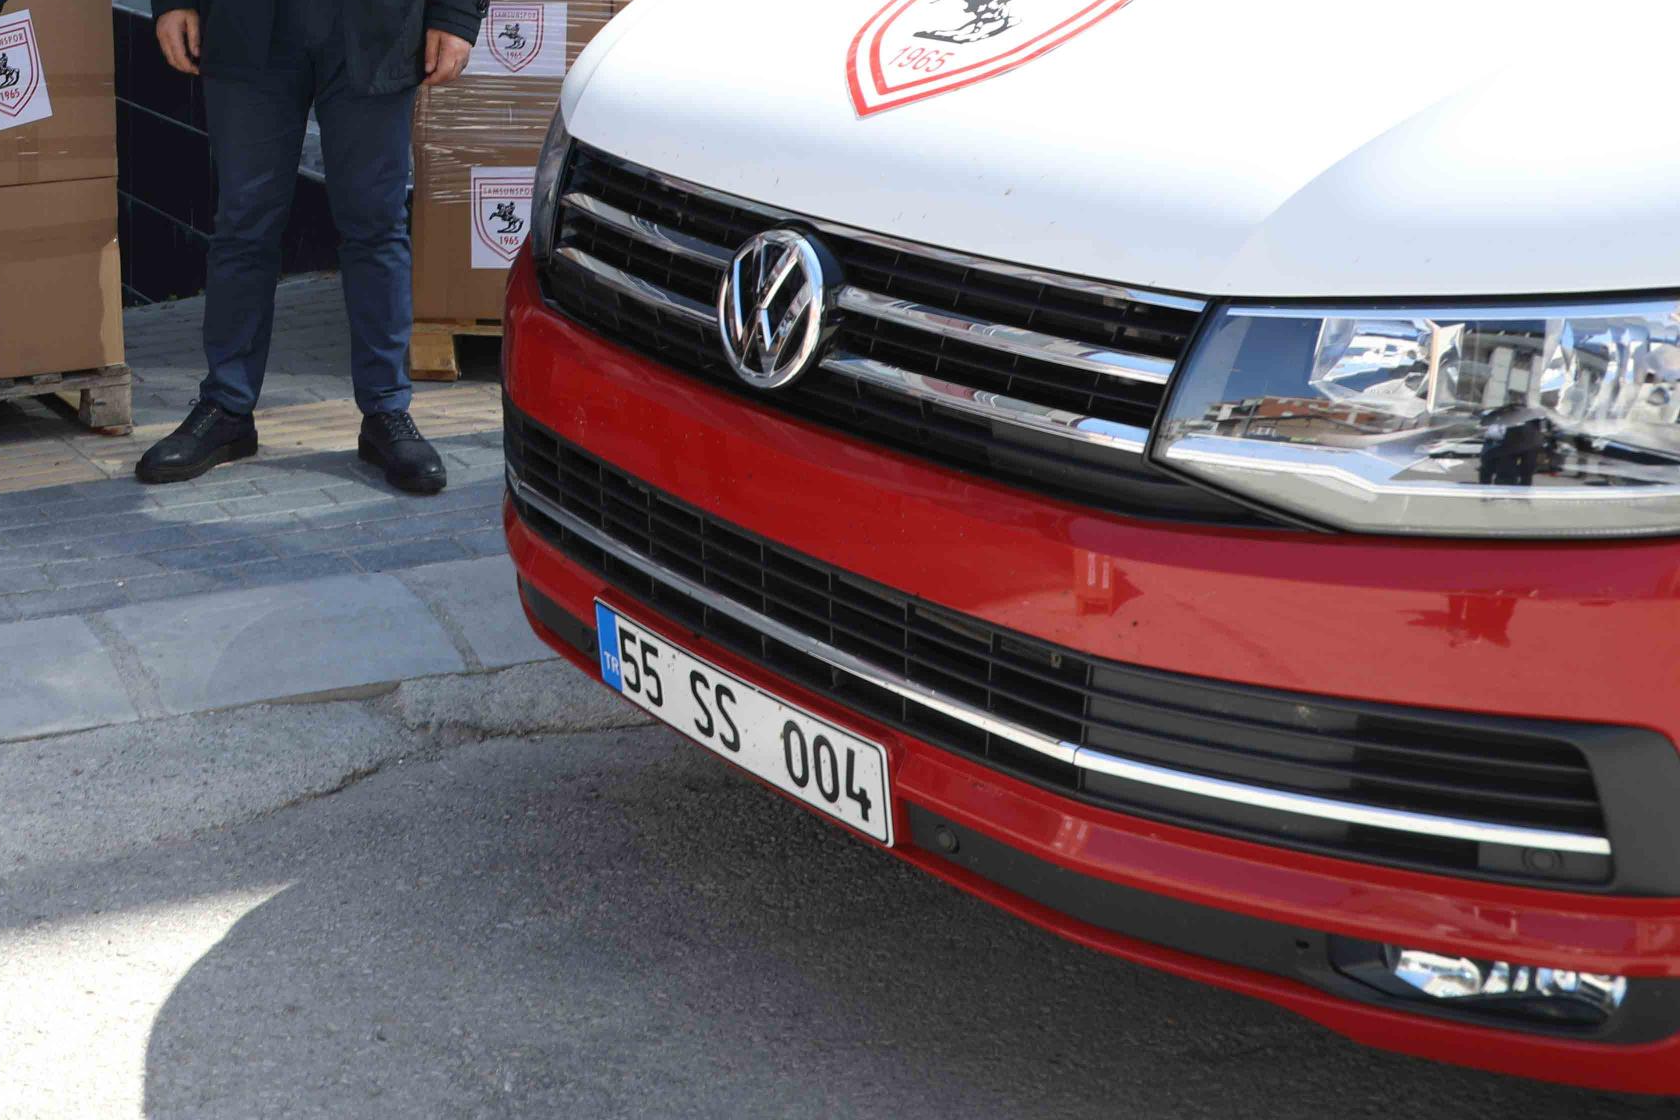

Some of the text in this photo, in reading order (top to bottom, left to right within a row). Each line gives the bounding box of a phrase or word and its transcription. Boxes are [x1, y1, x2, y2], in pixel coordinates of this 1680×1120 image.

[888, 45, 955, 74] 1965
[0, 88, 20, 101] 1965
[499, 235, 520, 246] 1965
[603, 650, 620, 676] TR
[619, 627, 872, 822] 55 SS 004
